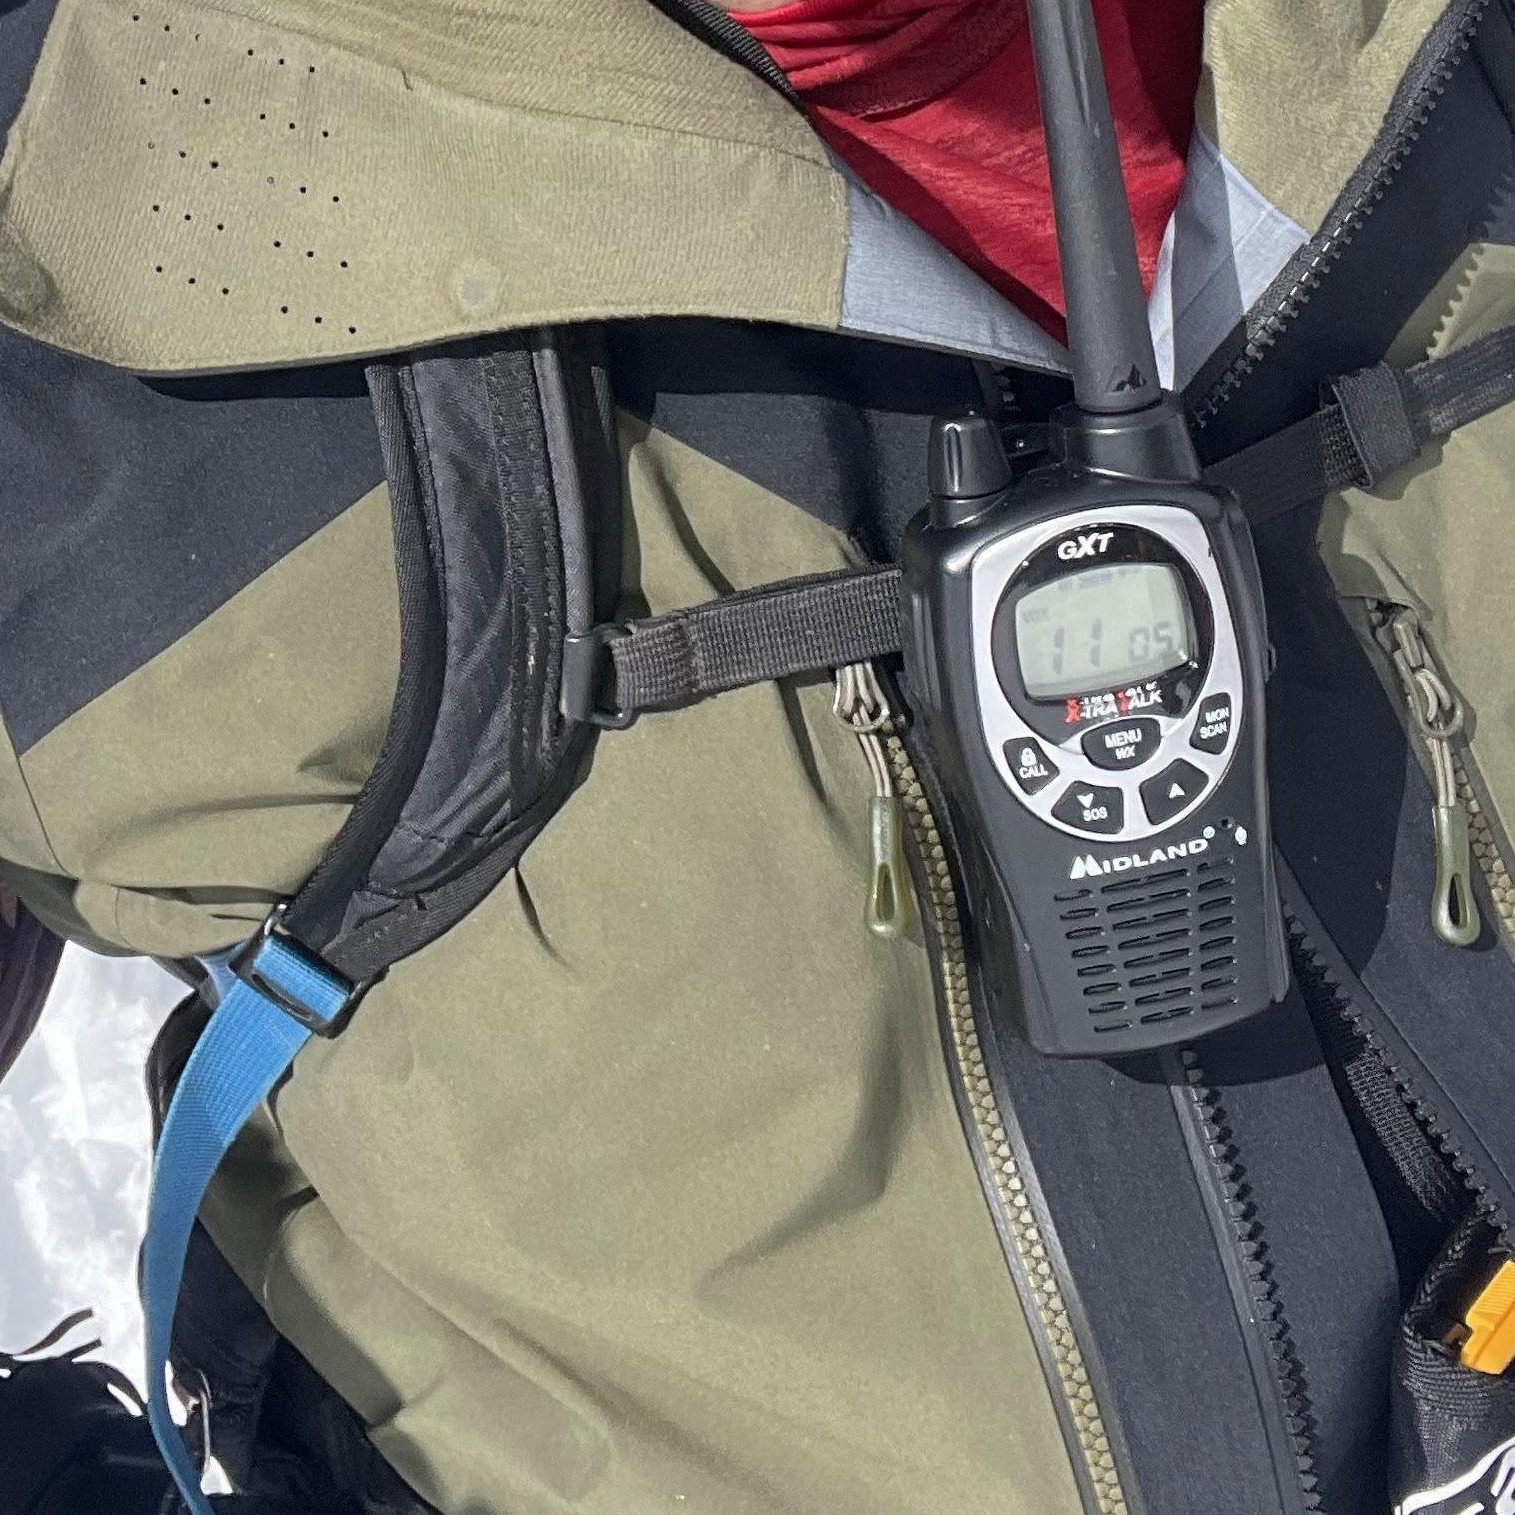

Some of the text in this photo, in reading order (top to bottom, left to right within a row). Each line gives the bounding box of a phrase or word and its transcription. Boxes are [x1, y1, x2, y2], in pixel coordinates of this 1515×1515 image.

[1057, 532, 1114, 560] GXT
[1205, 706, 1230, 723] MON
[1104, 728, 1142, 749] MENU
[1199, 721, 1228, 739] SCAN
[1115, 745, 1136, 760] WX
[1019, 763, 1049, 779] CALL
[1083, 806, 1108, 822] SOS
[1070, 838, 1209, 880] MIDLAND
